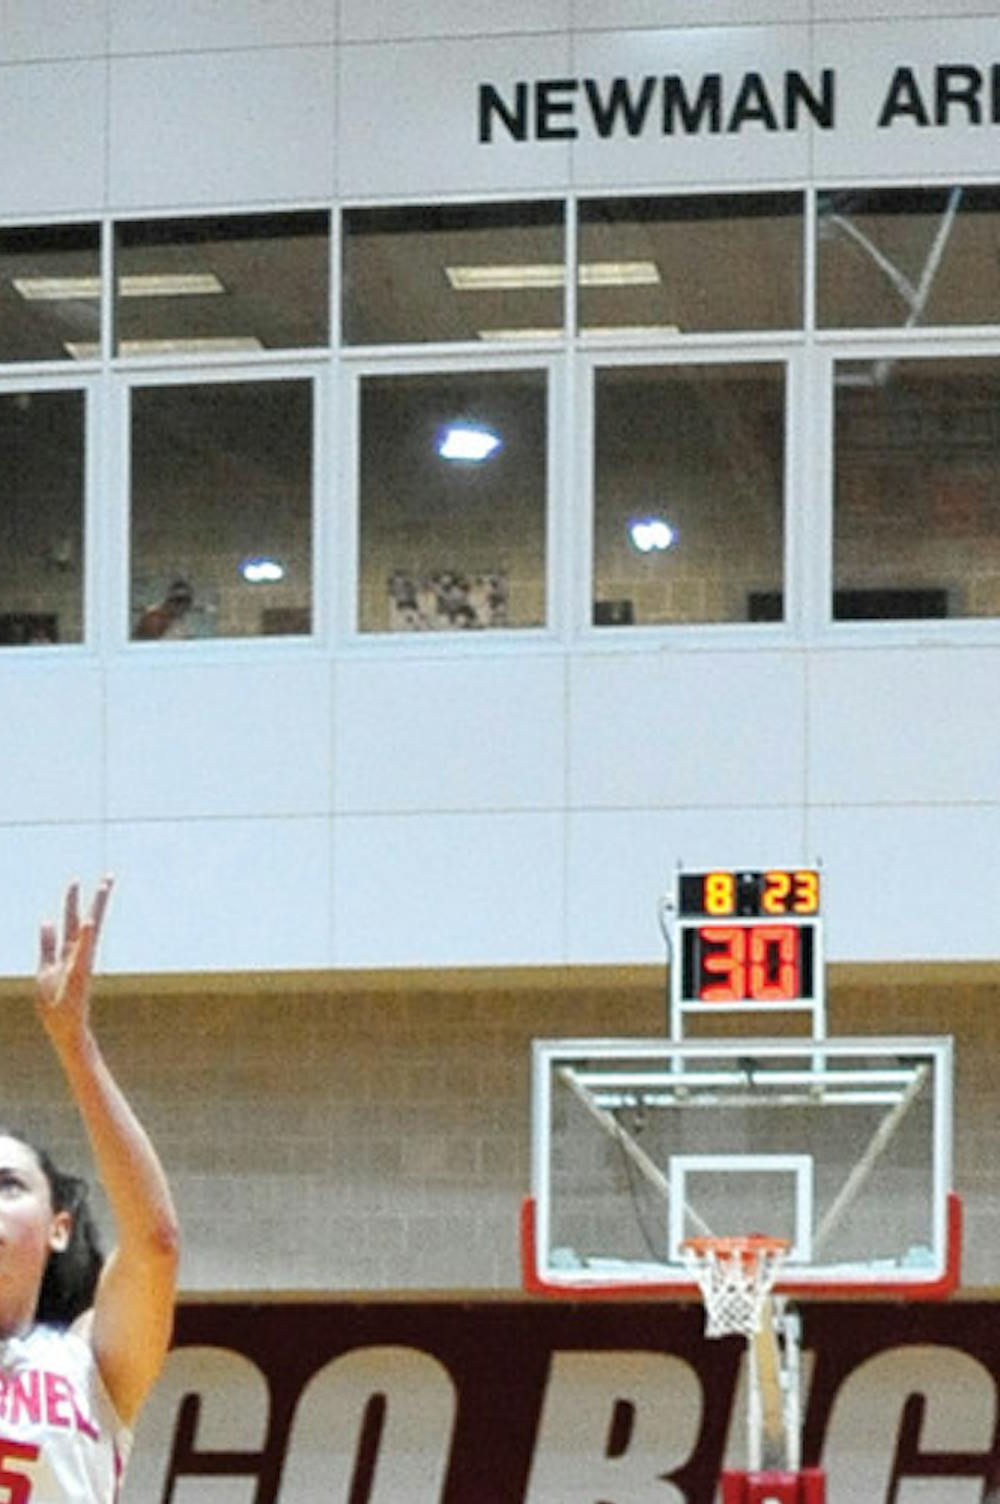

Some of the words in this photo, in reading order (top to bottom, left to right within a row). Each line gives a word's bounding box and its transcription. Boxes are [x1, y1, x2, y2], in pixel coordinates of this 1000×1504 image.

[478, 69, 836, 143] NEWMAN
[877, 64, 1000, 127] AR
[699, 925, 799, 1003] 30
